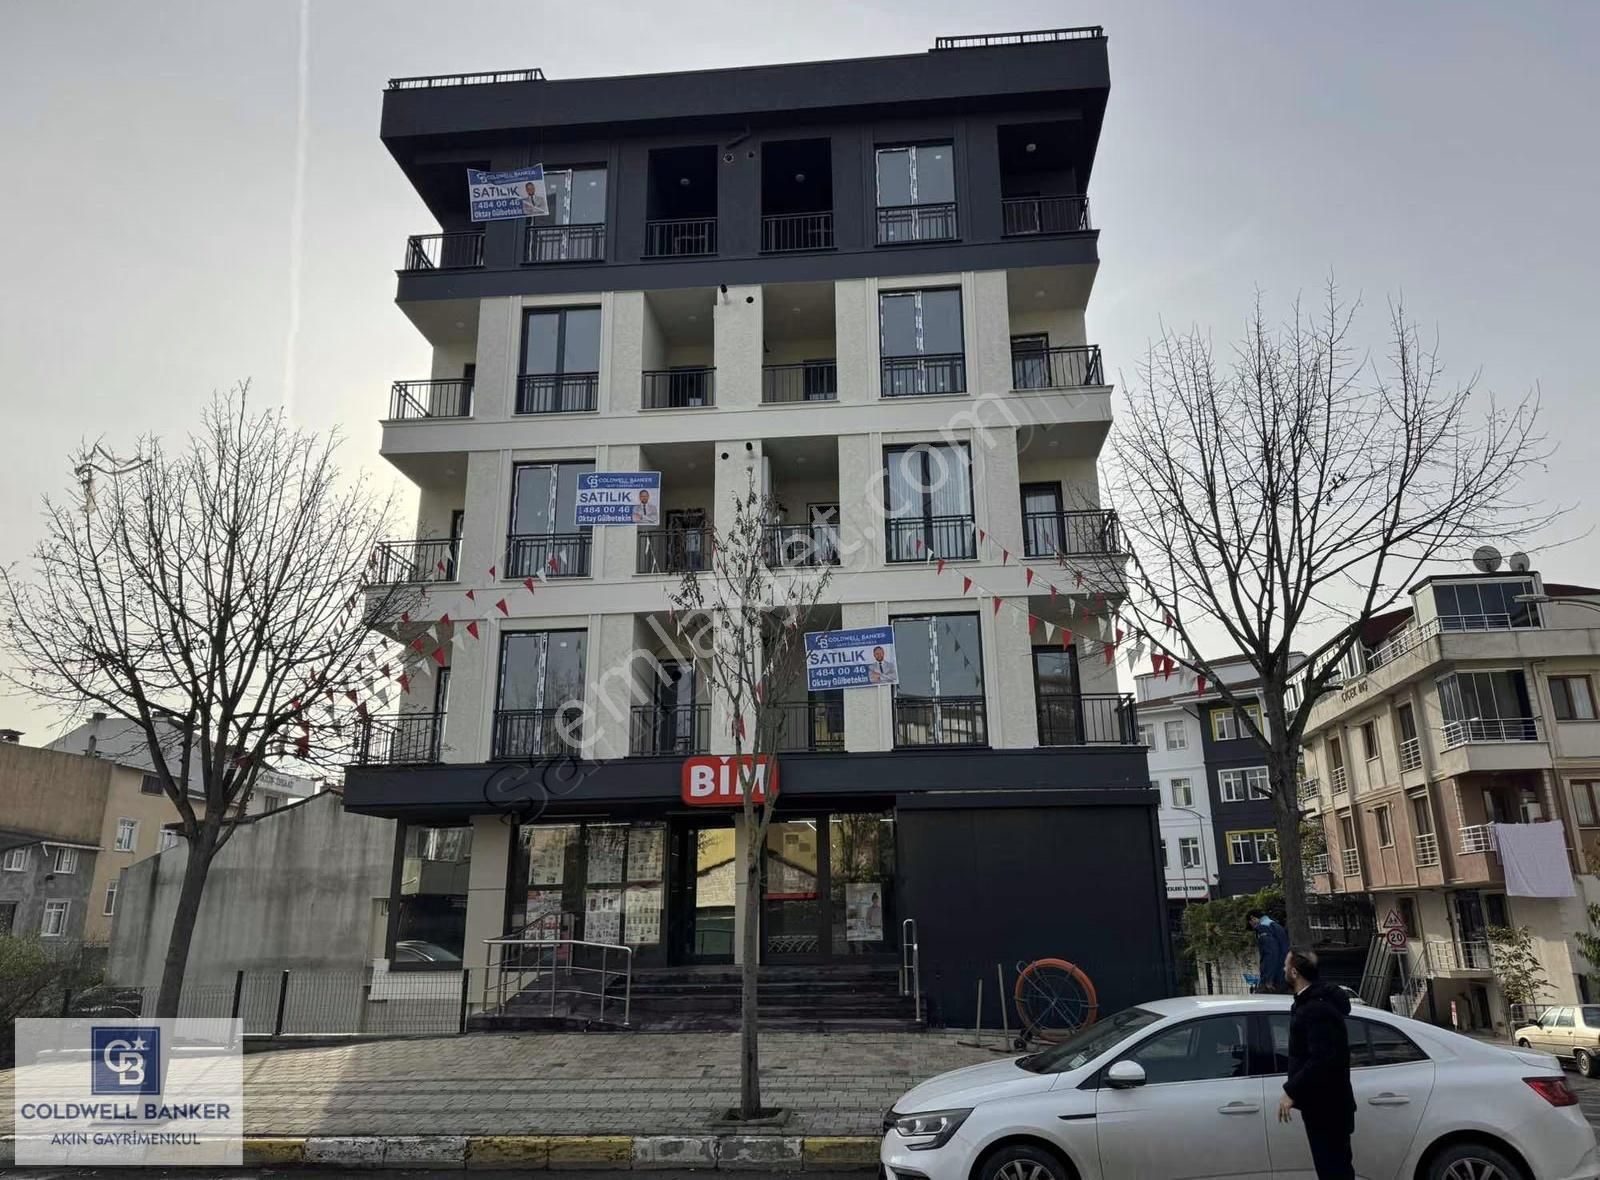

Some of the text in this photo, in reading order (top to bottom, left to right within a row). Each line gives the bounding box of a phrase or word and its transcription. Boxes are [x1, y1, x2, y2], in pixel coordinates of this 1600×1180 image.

[473, 186, 520, 199] SATILIK
[478, 200, 494, 209] 484
[496, 200, 507, 208] 00
[510, 199, 521, 207] 46
[474, 210, 491, 219] Oktay
[579, 491, 631, 503] SATILIK
[578, 515, 597, 523] Oktay
[810, 650, 866, 665] SATILIK
[816, 668, 834, 676] 484
[838, 667, 850, 675] 00
[853, 665, 866, 674] 46
[811, 676, 868, 687] Oktay Gülbetekin
[690, 756, 767, 797] BİM
[1391, 932, 1403, 943] 20
